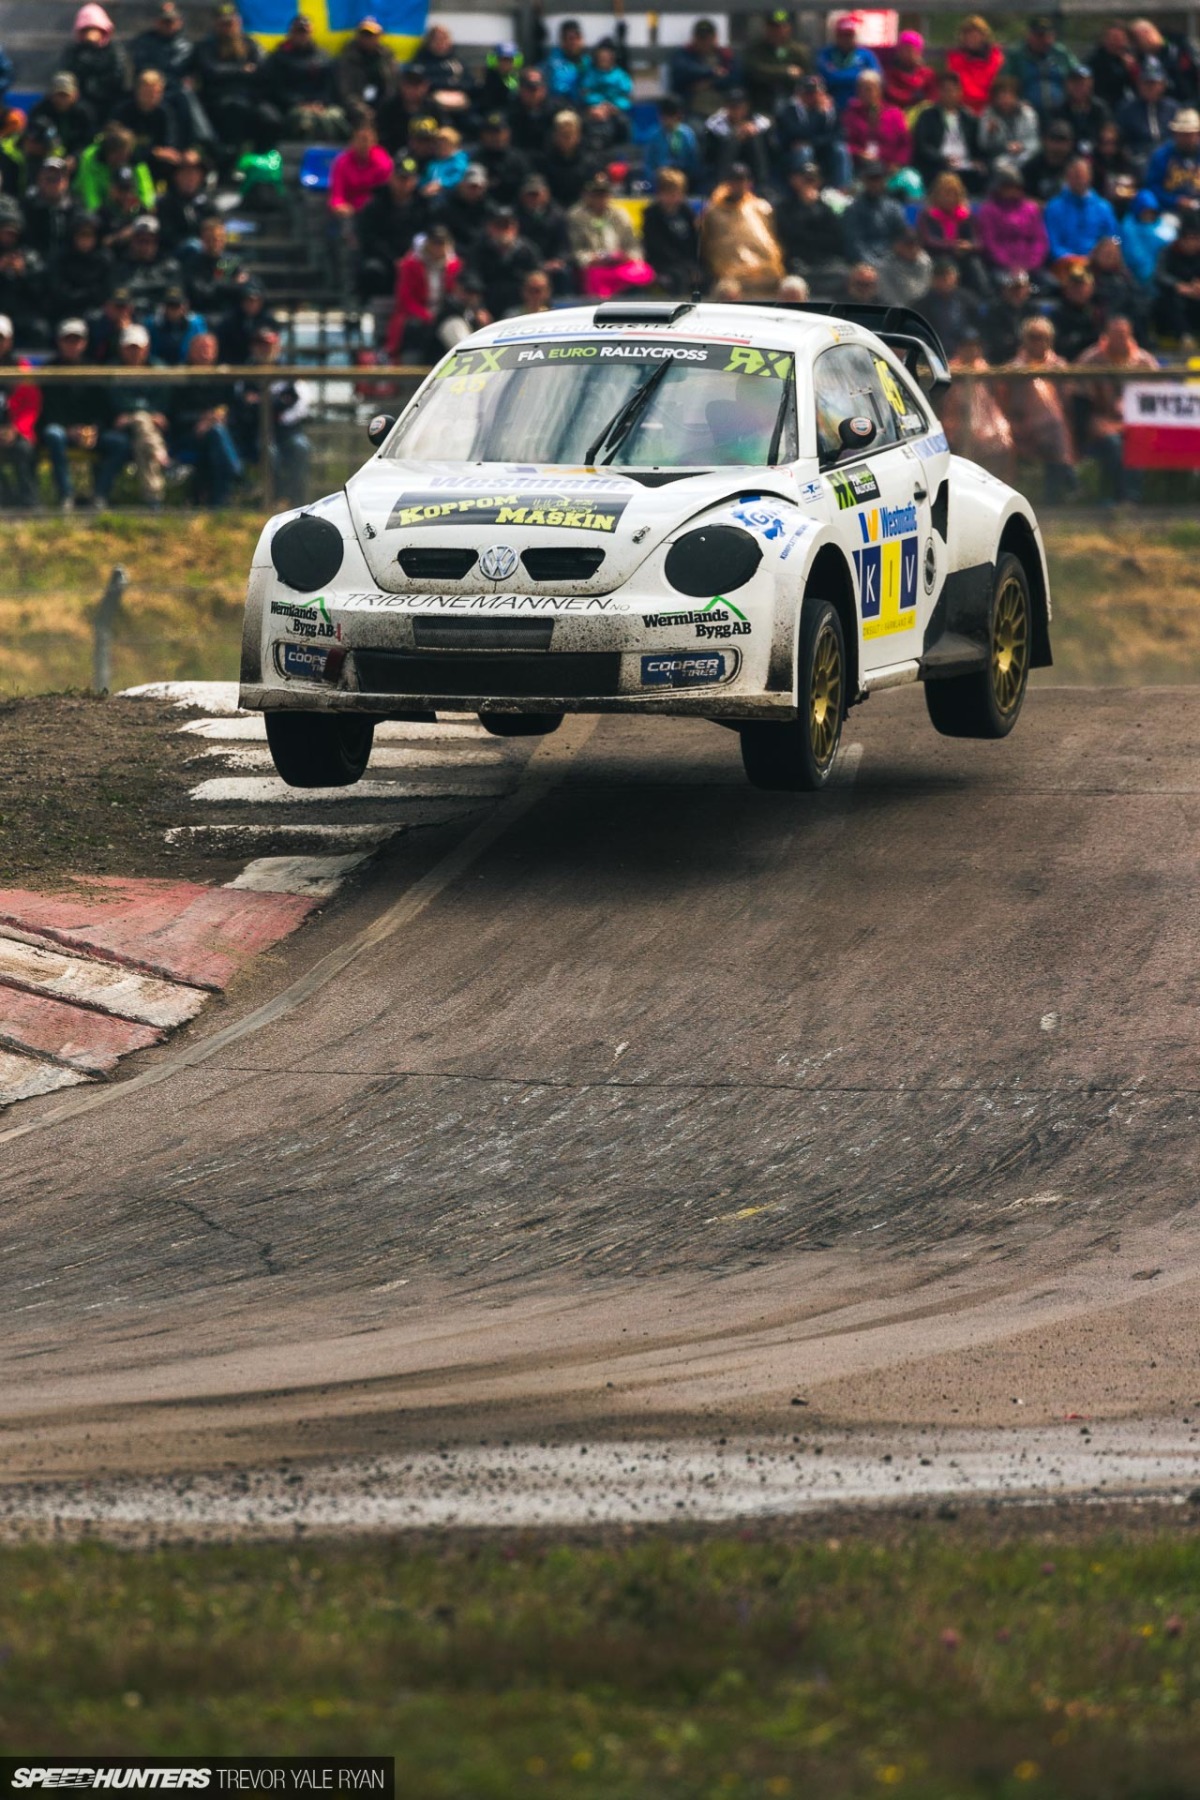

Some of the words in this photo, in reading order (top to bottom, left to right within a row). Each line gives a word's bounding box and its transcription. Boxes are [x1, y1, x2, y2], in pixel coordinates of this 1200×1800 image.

[518, 350, 545, 361] FIA
[548, 347, 597, 358] EURO
[600, 346, 708, 361] RALLYCROSS
[399, 494, 519, 526] KOPPOM
[880, 501, 918, 539] Westmatic
[271, 600, 318, 621] Wermlands
[343, 593, 613, 611] TRIBUNEMANNEN
[642, 608, 729, 628] Wermlands
[293, 619, 317, 638] Bygg
[317, 623, 334, 637] AB
[695, 624, 731, 640] Bygg
[732, 621, 752, 635] AB
[289, 652, 328, 666] COOPE
[647, 659, 719, 672] COOPER
